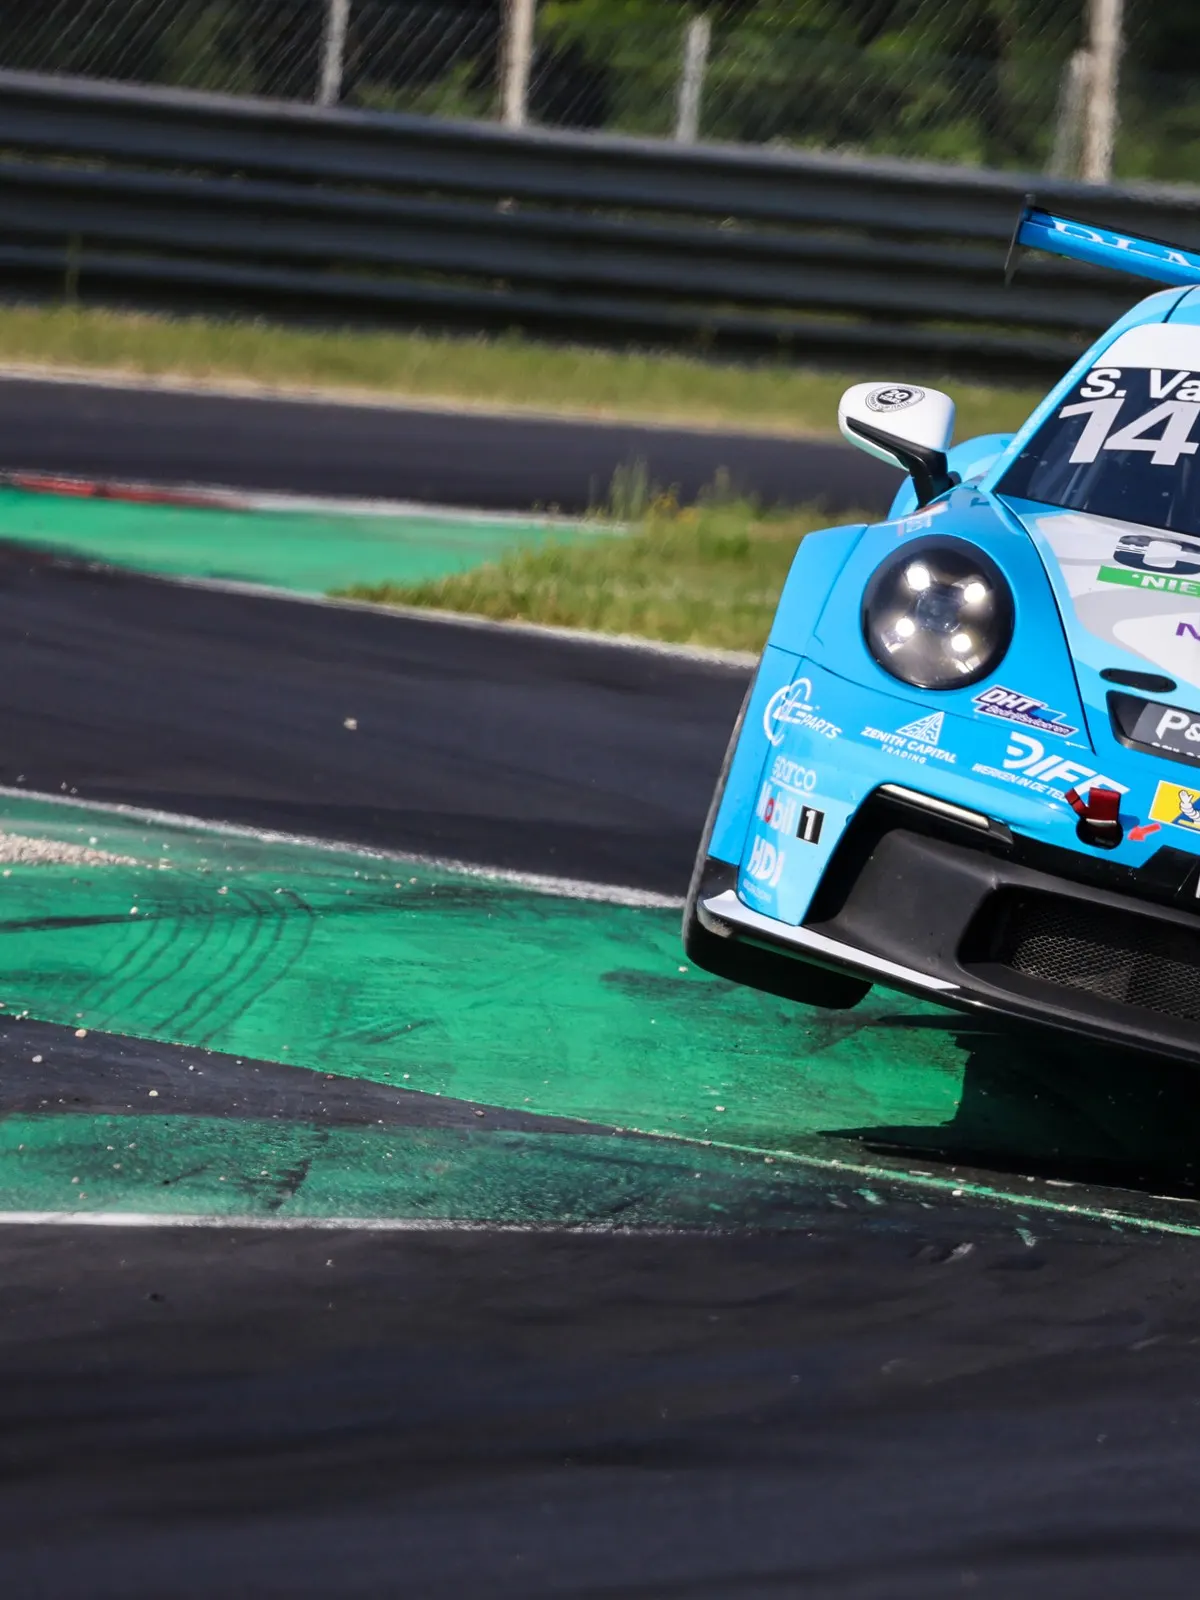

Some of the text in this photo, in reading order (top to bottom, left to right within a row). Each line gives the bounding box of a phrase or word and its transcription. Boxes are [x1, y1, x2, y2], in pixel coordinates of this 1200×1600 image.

[1080, 367, 1127, 398] S.
[980, 687, 1037, 712] DHT
[800, 714, 843, 739] PARTS
[860, 725, 957, 764] ZENITH CAPITAL
[881, 744, 927, 765] TRADING
[1002, 730, 1130, 797] DIFF
[1030, 780, 1048, 793] DE
[756, 780, 817, 840] Mobil 1
[746, 834, 785, 889] HDI
